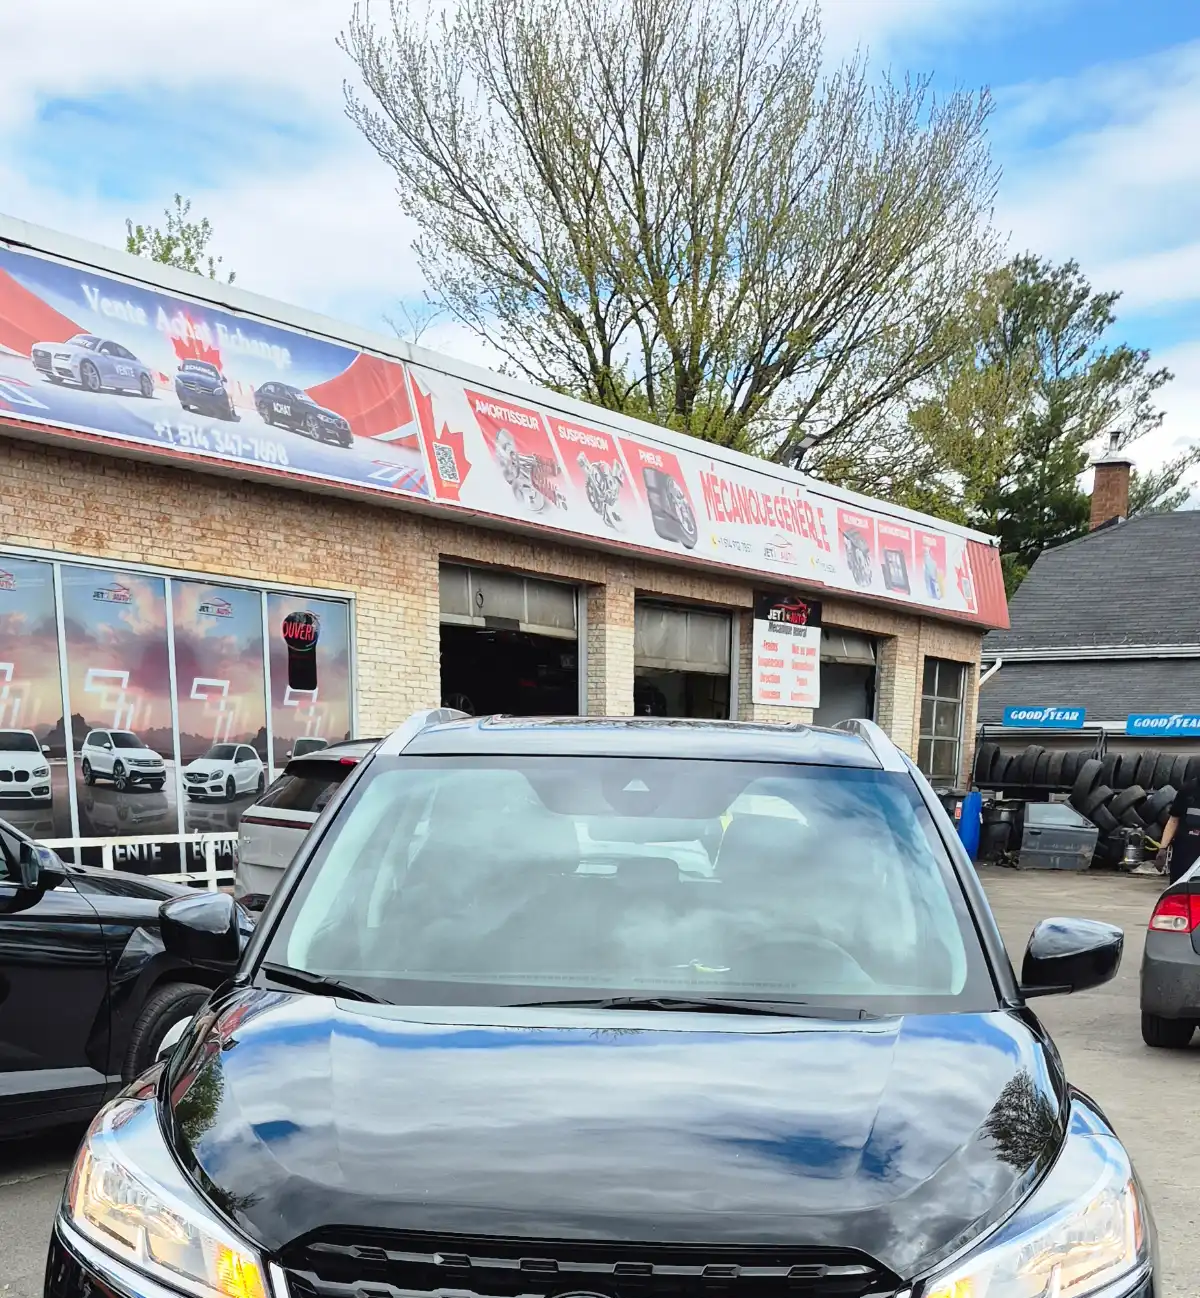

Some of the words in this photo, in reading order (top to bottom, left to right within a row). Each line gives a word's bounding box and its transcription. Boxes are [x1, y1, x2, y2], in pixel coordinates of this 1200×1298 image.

[81, 283, 148, 326] Vente
[475, 399, 540, 431] AMORTISSEUR
[558, 425, 609, 451] SUSPENSION
[282, 621, 316, 641] OUVERT
[1010, 707, 1079, 722] GOODYEAR
[114, 841, 161, 861] ENTE
